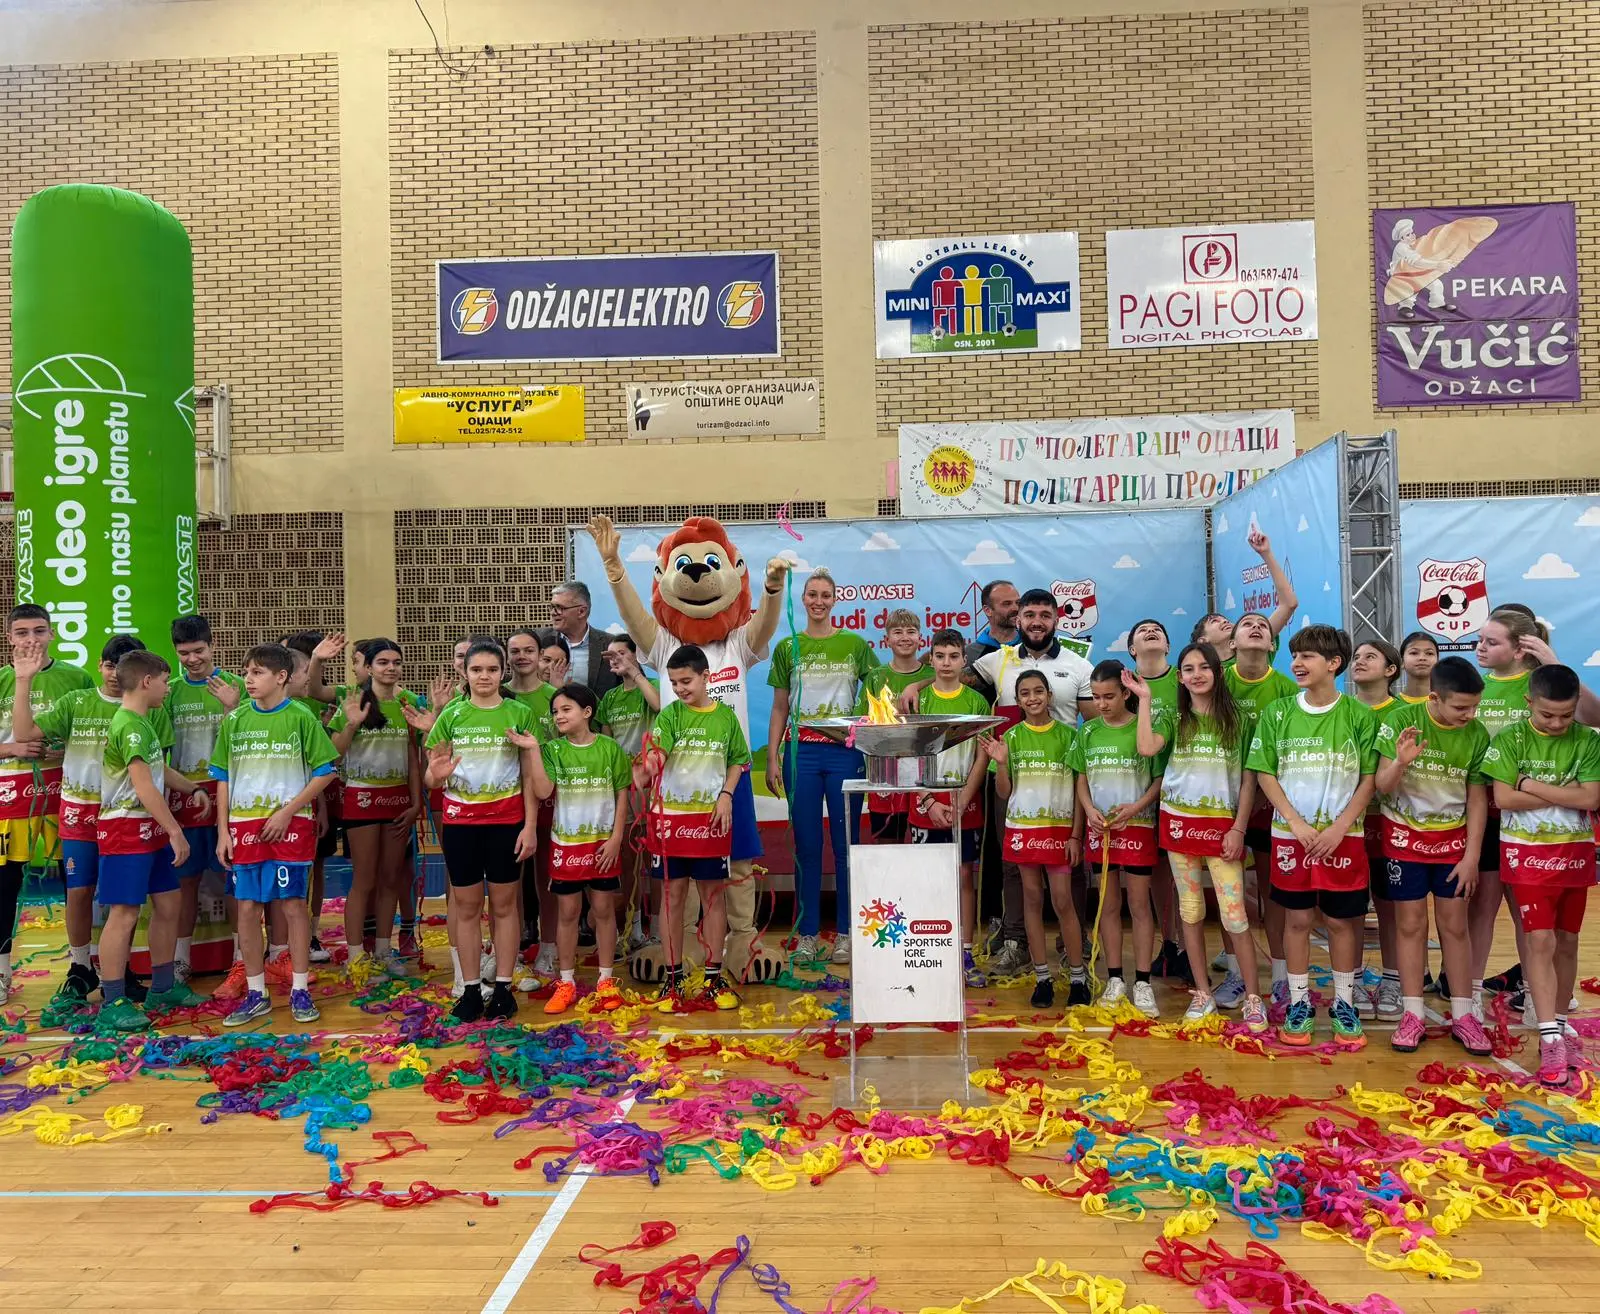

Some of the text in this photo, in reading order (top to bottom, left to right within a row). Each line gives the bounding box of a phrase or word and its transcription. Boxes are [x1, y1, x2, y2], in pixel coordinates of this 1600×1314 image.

[910, 241, 1035, 274] FOOTBALL LEAGUE
[1452, 276, 1567, 298] PEKARA
[888, 297, 930, 312] MINI
[1016, 290, 1066, 306] MAXI
[505, 283, 710, 331] ODŽACIELEKTRO
[1119, 287, 1304, 330] PAGI FOTO
[1122, 327, 1303, 344] DIGITAL PHOTOLAB
[954, 339, 995, 348] OSN. 2001
[1386, 322, 1569, 370] Vučić
[650, 382, 815, 397] ТУРИСТИЧКА ОРГАНИЗАЦИЈА
[1424, 376, 1536, 397] ODŽACI
[420, 389, 559, 399] ЈАВНО-КОМУНАЛНО ПРДУЗЕЋЕ
[685, 395, 784, 408] ОПШТИНЕ ОЏАЦИ
[468, 417, 512, 427] ОЏАЦИ
[697, 420, 770, 430] turizam@odzaci.info
[458, 427, 522, 435] TEL.025/742-512
[999, 427, 1279, 461] ПУ "ПОЛЕТАРАЦ" ОЏАЦИ
[102, 401, 137, 504] planetu
[1003, 474, 1157, 507] ПОЛЕТАРЦИ
[43, 399, 98, 668] udi deo igre
[104, 512, 131, 577] našu
[176, 514, 194, 615] WASTE
[1423, 563, 1480, 582] Coca-Cola
[859, 583, 914, 600] WASTE
[1053, 582, 1091, 596] Coca-Cola
[831, 608, 866, 630] udi
[925, 606, 971, 632] igre
[1437, 621, 1471, 630] CUP
[809, 661, 848, 672] deo igre
[185, 713, 206, 723] deo
[1484, 708, 1531, 719] deo igre
[72, 728, 95, 737] budi
[472, 735, 491, 744] deo
[250, 741, 269, 750] deo
[271, 740, 292, 752] igre
[688, 738, 706, 748] deo
[1193, 744, 1213, 754] deo
[1293, 737, 1322, 747] WASTE
[1101, 756, 1118, 765] deo
[1121, 755, 1137, 767] igre
[1300, 749, 1325, 761] deo
[1029, 760, 1046, 768] deo
[1426, 761, 1444, 771] deo
[1447, 763, 1468, 776] igre
[571, 777, 588, 785] deo
[675, 825, 710, 839] Coca-Cola
[1412, 840, 1450, 854] Coca-Cola
[1323, 856, 1352, 869] CUP
[1524, 856, 1586, 870] Coca-Cola CUP
[277, 866, 290, 887] 9
[913, 922, 947, 933] plazma
[904, 938, 953, 948] SPORTSKE
[904, 949, 926, 958] IGRE
[904, 960, 943, 968] MLADIH
